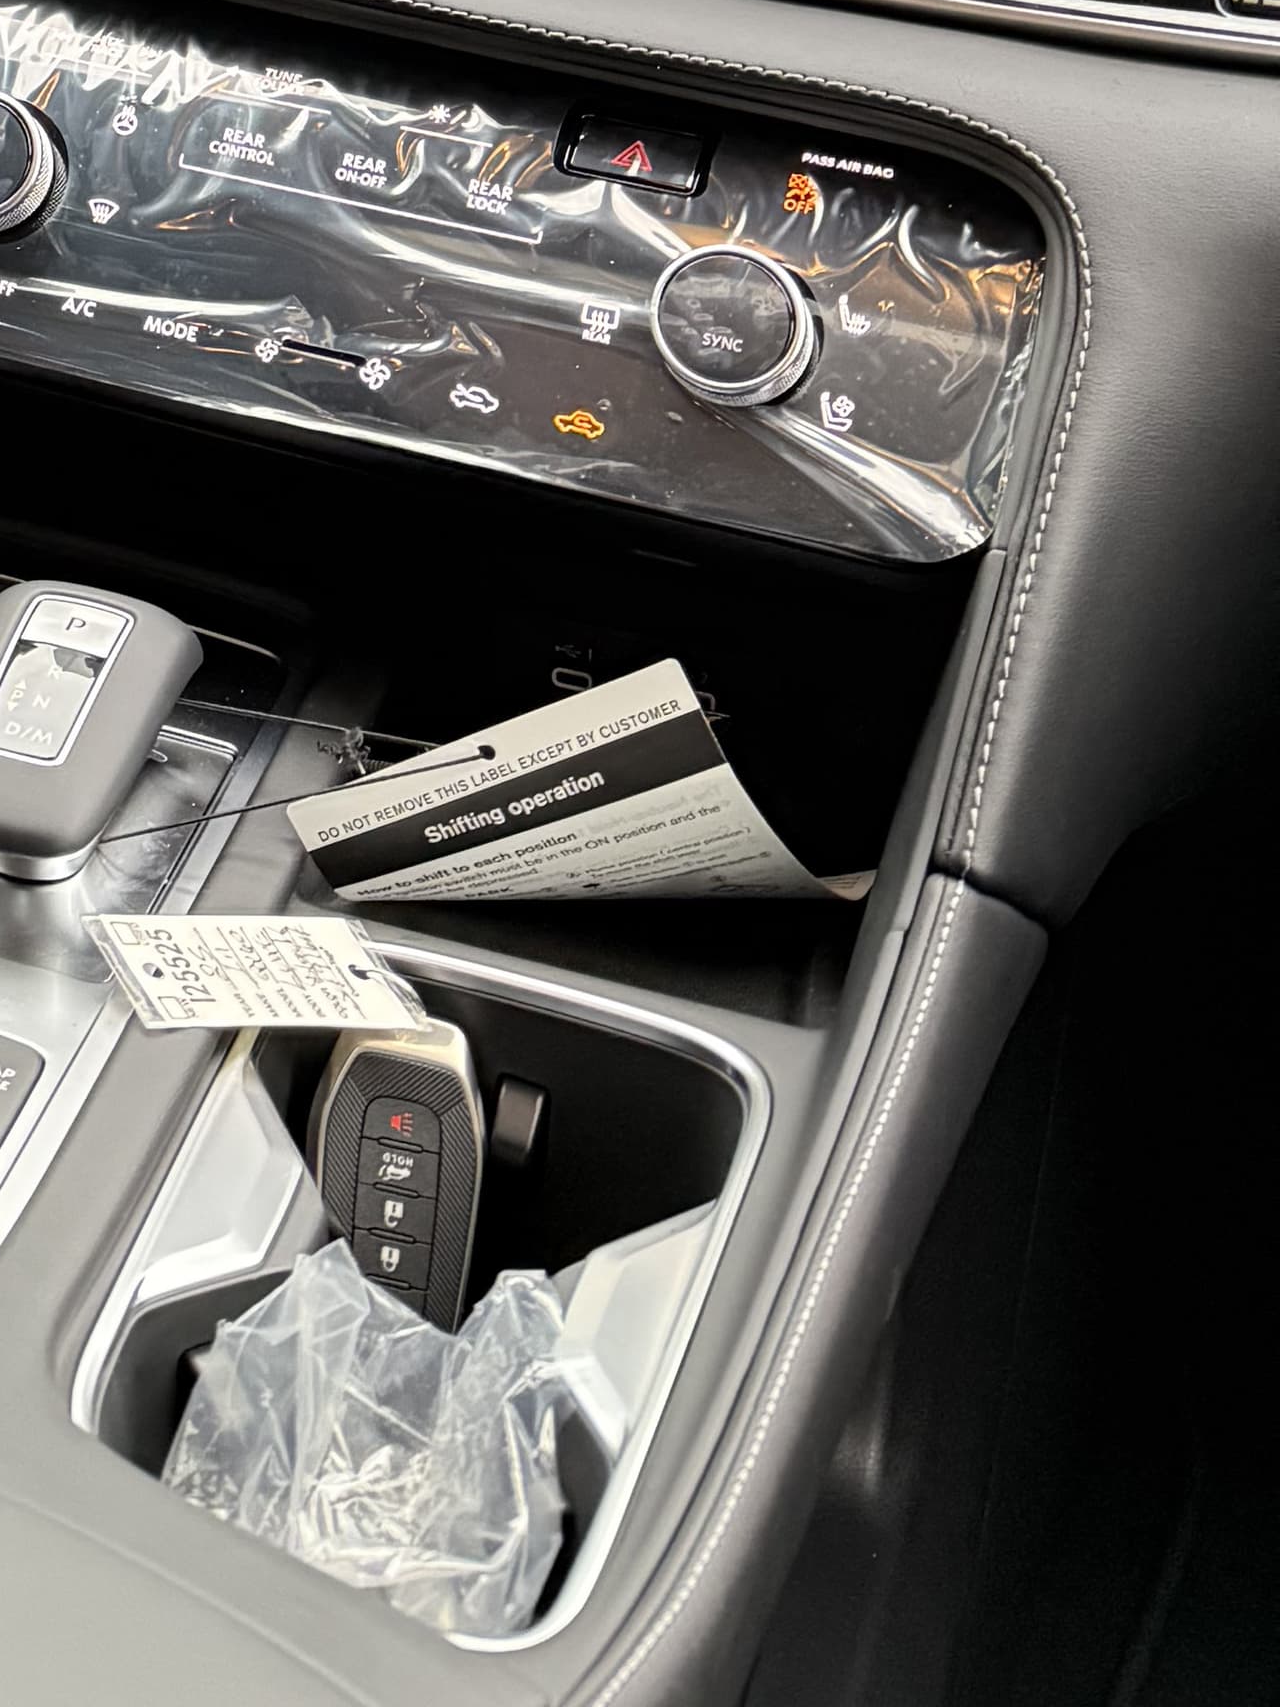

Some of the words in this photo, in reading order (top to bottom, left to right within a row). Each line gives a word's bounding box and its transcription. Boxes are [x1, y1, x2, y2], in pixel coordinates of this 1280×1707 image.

[265, 67, 303, 83] TUNE
[222, 127, 265, 149] REAR
[208, 140, 274, 166] CONTROL
[342, 152, 387, 174] REAR
[801, 152, 836, 167] PASS
[836, 160, 861, 173] AIR
[862, 164, 894, 179] BAG
[468, 179, 513, 201] REAR
[466, 196, 508, 215] LOCK
[783, 199, 814, 214] OFF
[61, 297, 97, 318] A/C
[143, 315, 198, 343] MODE
[582, 330, 611, 345] REAR
[702, 333, 743, 352] SYNC
[65, 617, 87, 631] P
[32, 694, 51, 708] N
[4, 721, 53, 745] D/M
[317, 826, 340, 842] DO
[344, 815, 371, 835] NOT
[374, 792, 434, 822] REMOVE
[437, 780, 469, 800] THIS
[470, 763, 518, 787] LABEL
[518, 739, 573, 769] EXCEPT
[575, 730, 596, 748] BY
[599, 699, 681, 739] CUSTOMER
[424, 808, 505, 844] Shifting
[508, 770, 605, 816] operation
[525, 856, 543, 867] be
[546, 852, 559, 862] in
[560, 845, 583, 858] the
[585, 836, 610, 850] ON
[614, 821, 667, 844] position
[670, 811, 696, 826] and
[698, 803, 722, 818] the
[395, 879, 412, 887] to
[414, 869, 451, 885] shift
[452, 864, 470, 874] to
[474, 851, 511, 868] each
[515, 832, 578, 859] position
[145, 928, 216, 1003] 125525
[383, 1152, 413, 1167] HOLD
